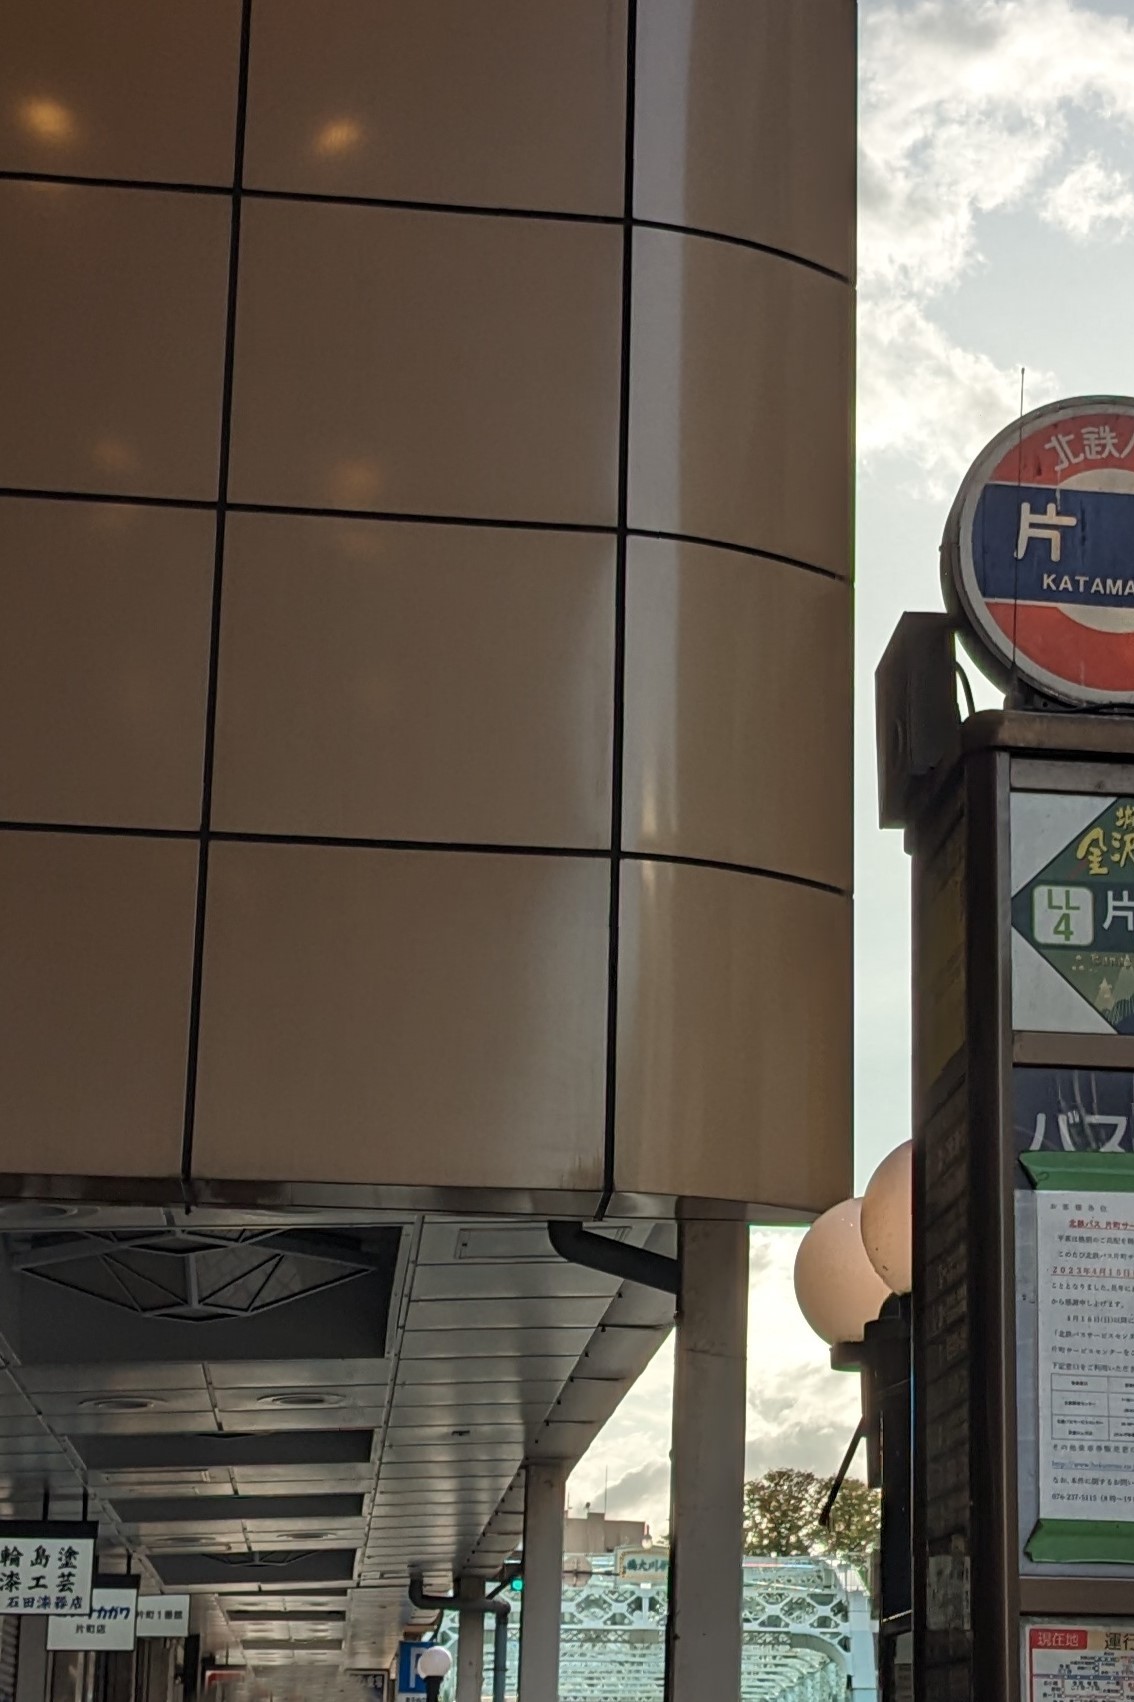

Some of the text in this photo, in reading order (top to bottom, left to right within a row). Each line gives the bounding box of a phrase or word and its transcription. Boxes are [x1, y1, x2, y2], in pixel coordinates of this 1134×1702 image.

[1047, 889, 1081, 911] LL
[1052, 913, 1075, 942] 4
[1037, 1630, 1079, 1648] 現在地
